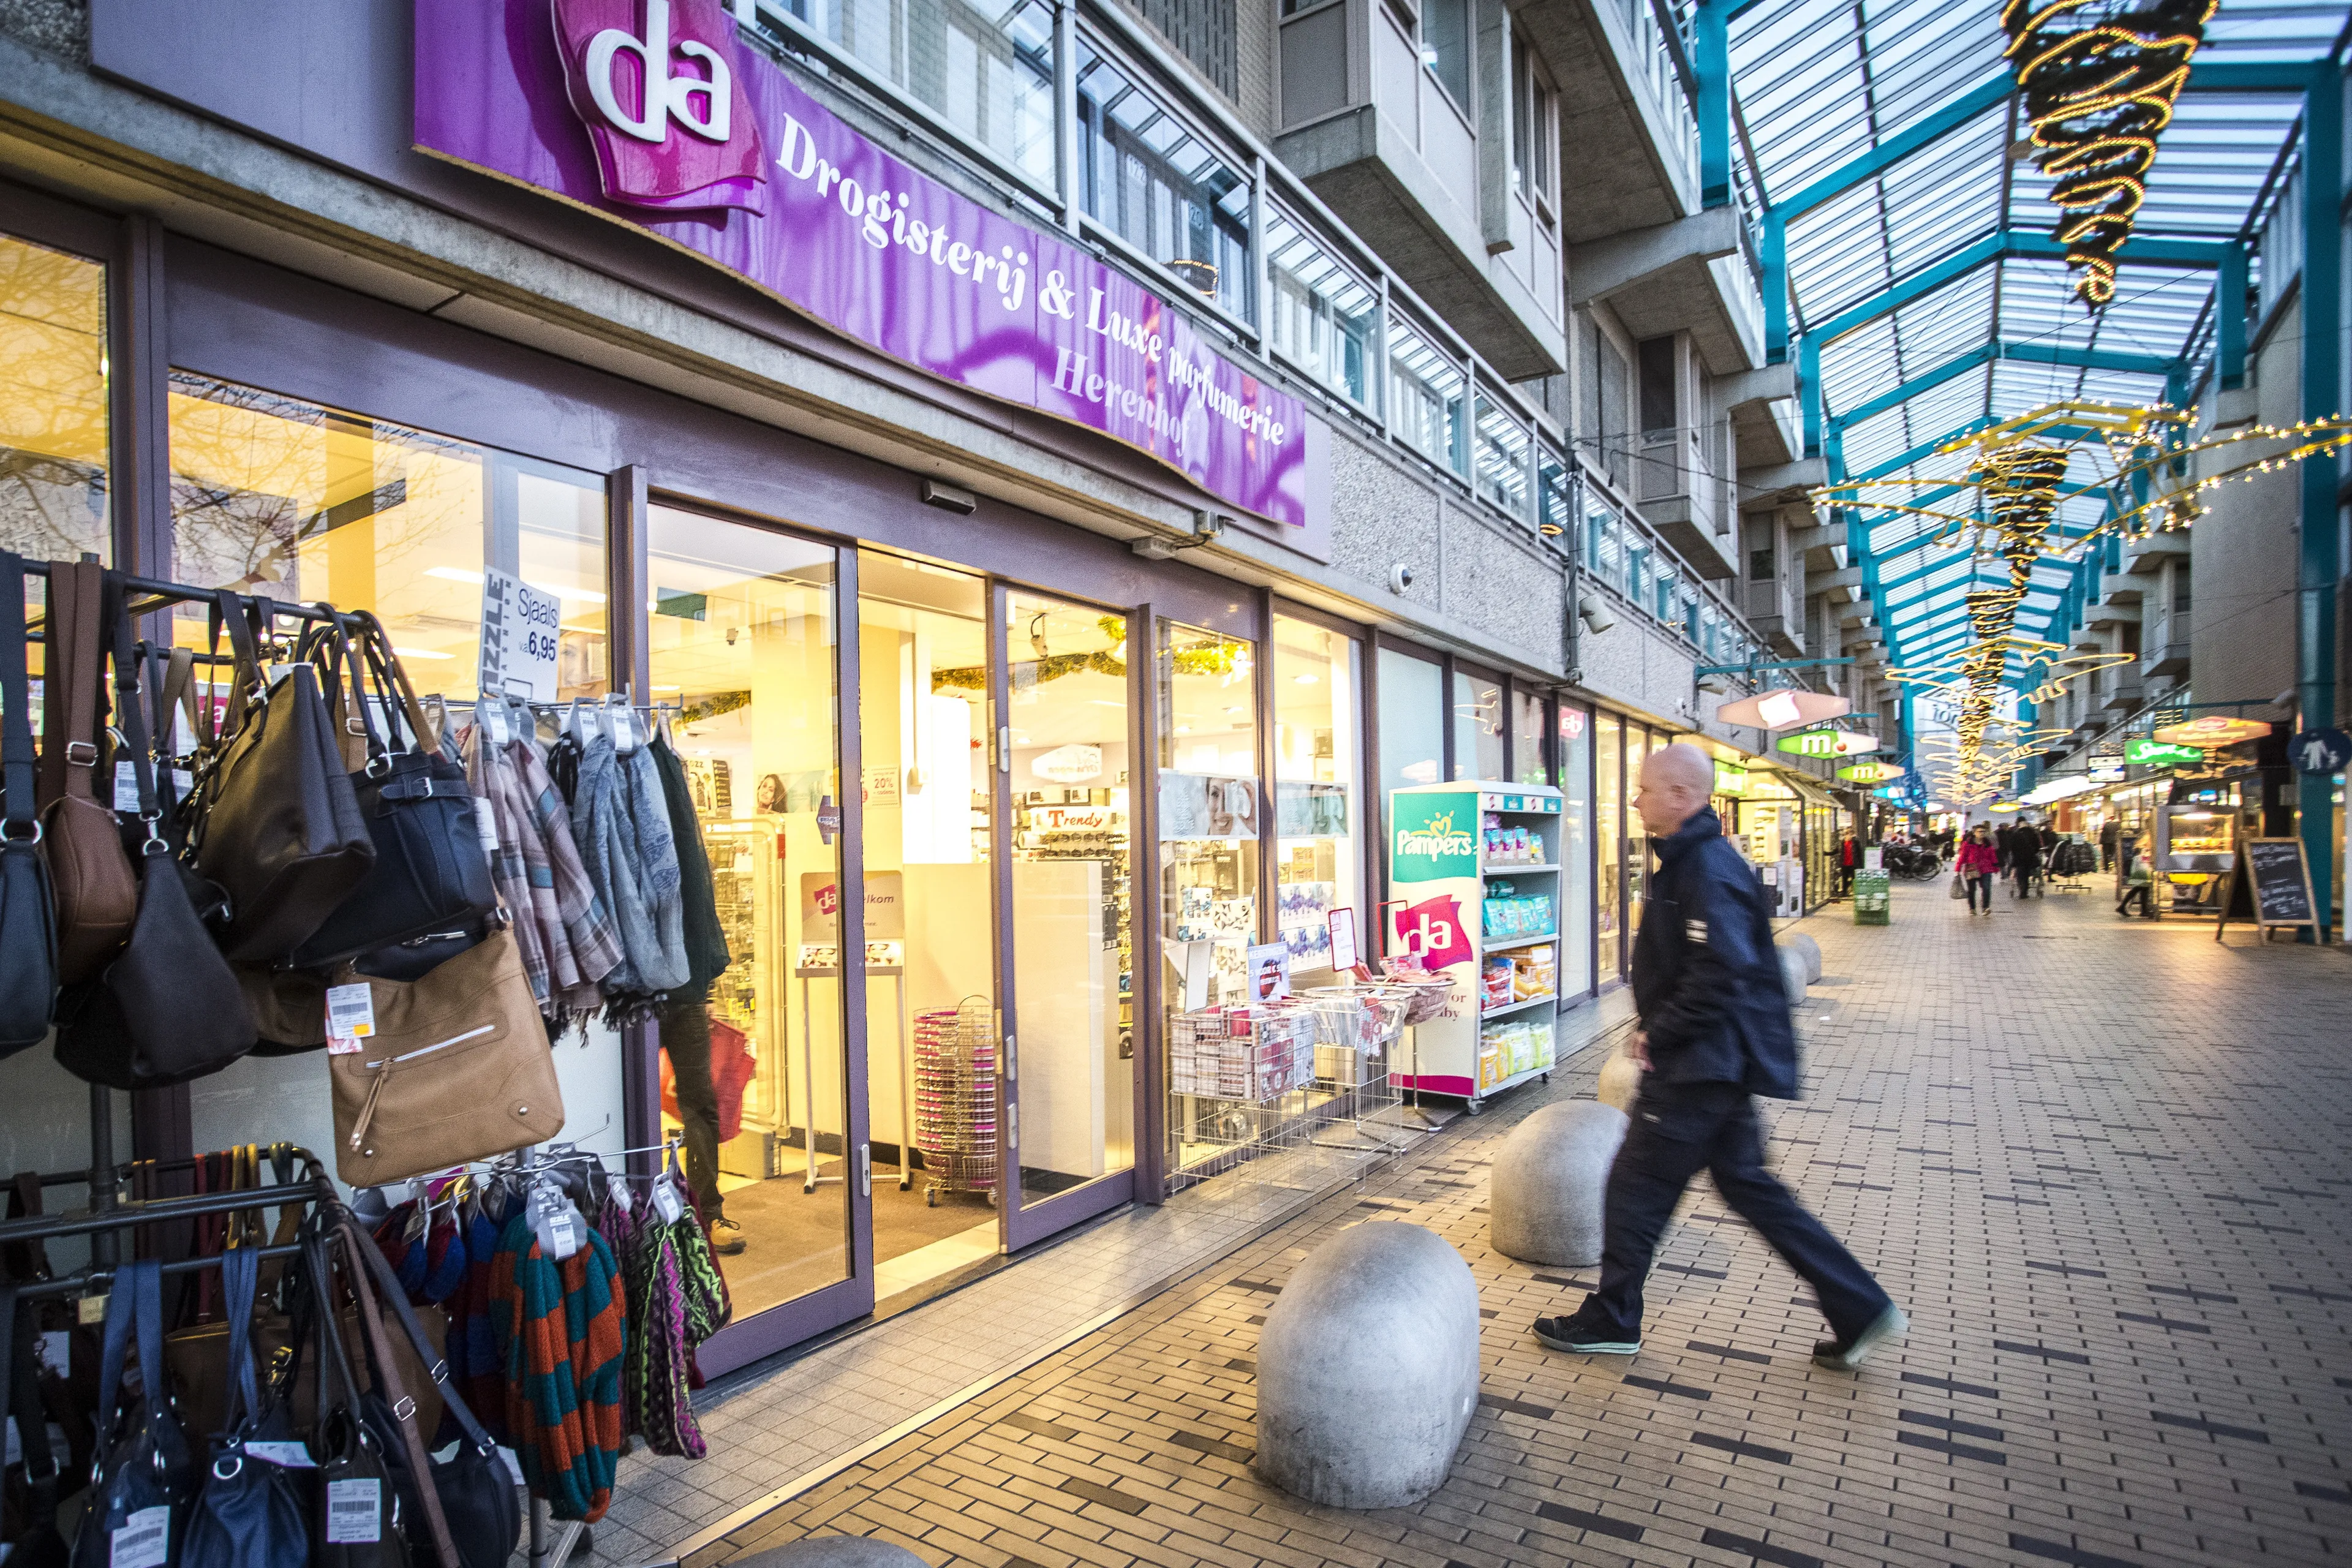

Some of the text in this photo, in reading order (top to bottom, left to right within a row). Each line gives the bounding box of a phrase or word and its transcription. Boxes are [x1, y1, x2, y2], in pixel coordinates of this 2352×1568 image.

[585, 0, 731, 143] da
[775, 111, 1285, 446] Drogisterij & Luxe parfumerie
[1051, 345, 1191, 458] Herenhof
[518, 588, 558, 628] Sjaals
[529, 631, 556, 662] 6,95
[874, 777, 894, 789] 20%
[1048, 810, 1103, 828] Trendy
[1396, 829, 1473, 862] Pampers
[817, 891, 894, 909] da lkom
[1401, 913, 1452, 958] da
